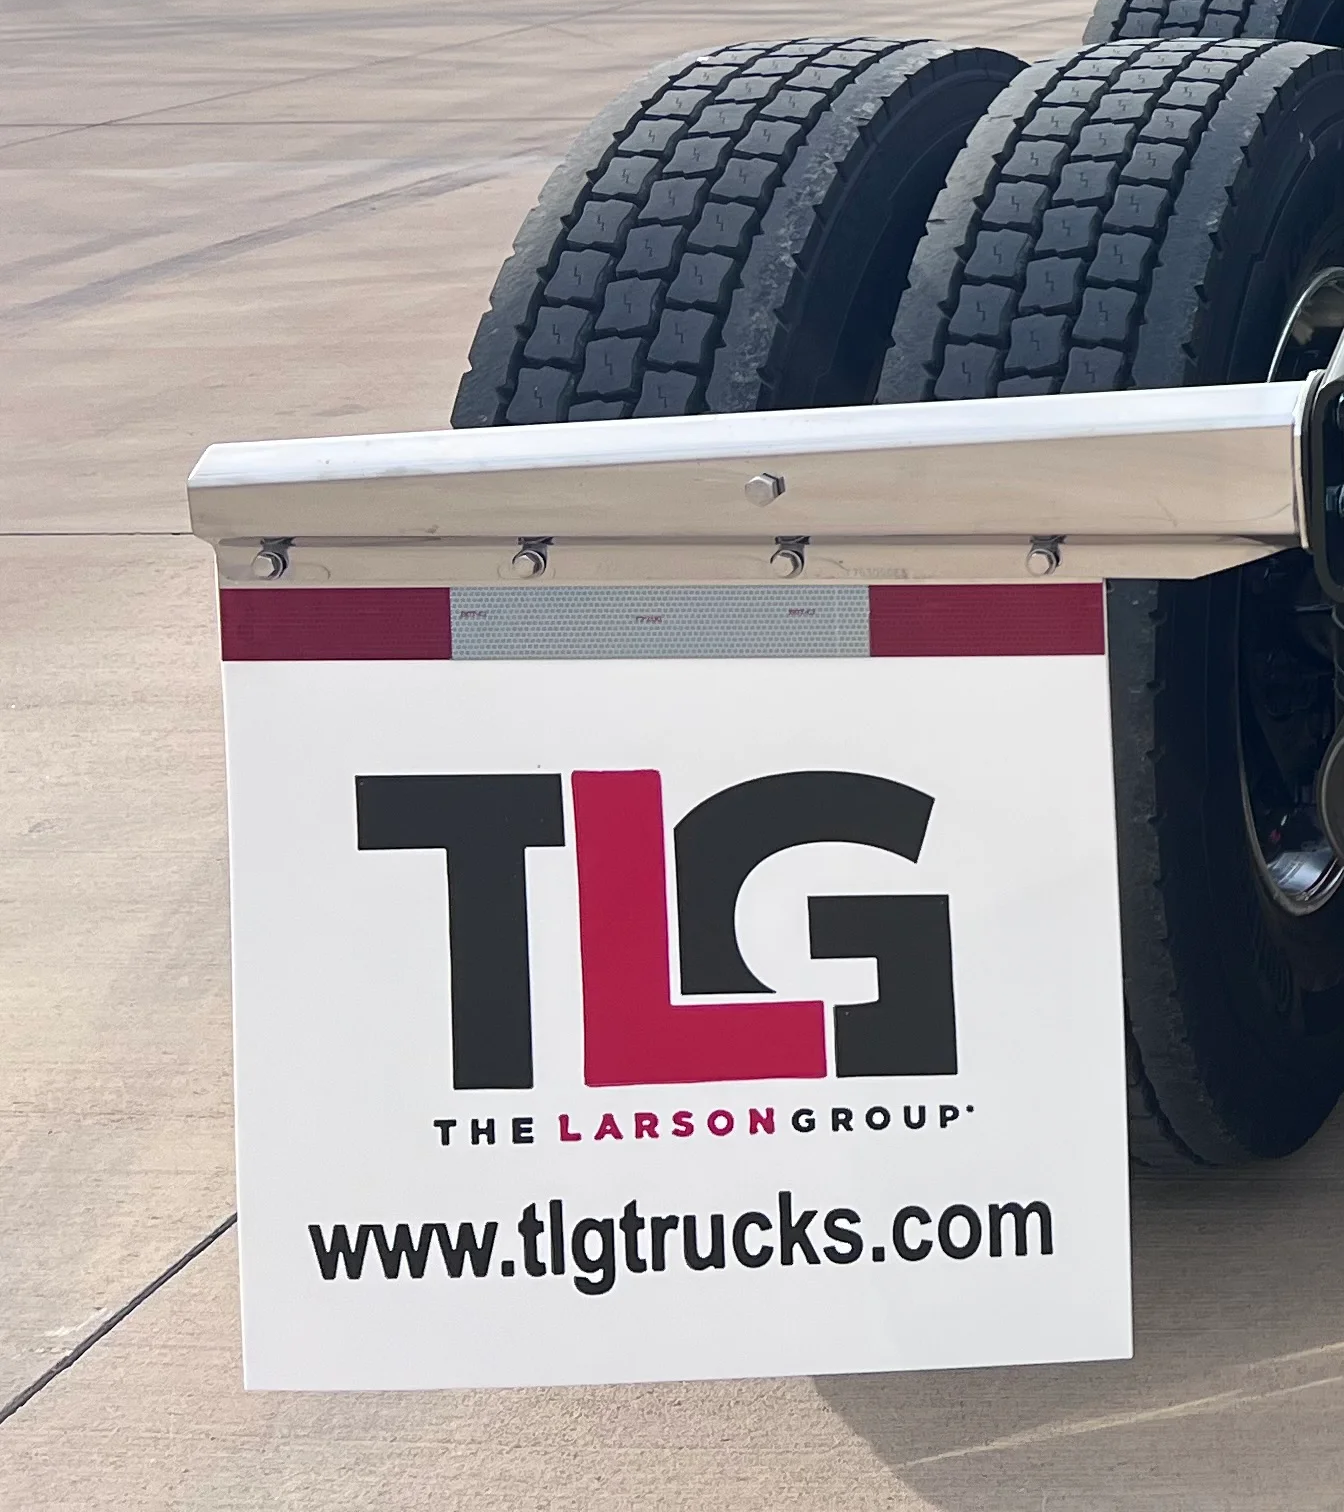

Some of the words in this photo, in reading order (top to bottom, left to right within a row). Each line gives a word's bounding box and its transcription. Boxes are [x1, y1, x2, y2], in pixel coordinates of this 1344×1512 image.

[355, 769, 959, 1090] TLG
[433, 1113, 535, 1146] THE
[558, 1107, 776, 1142] LARSON
[308, 1190, 1054, 1296] www.tlgtrucks.com
